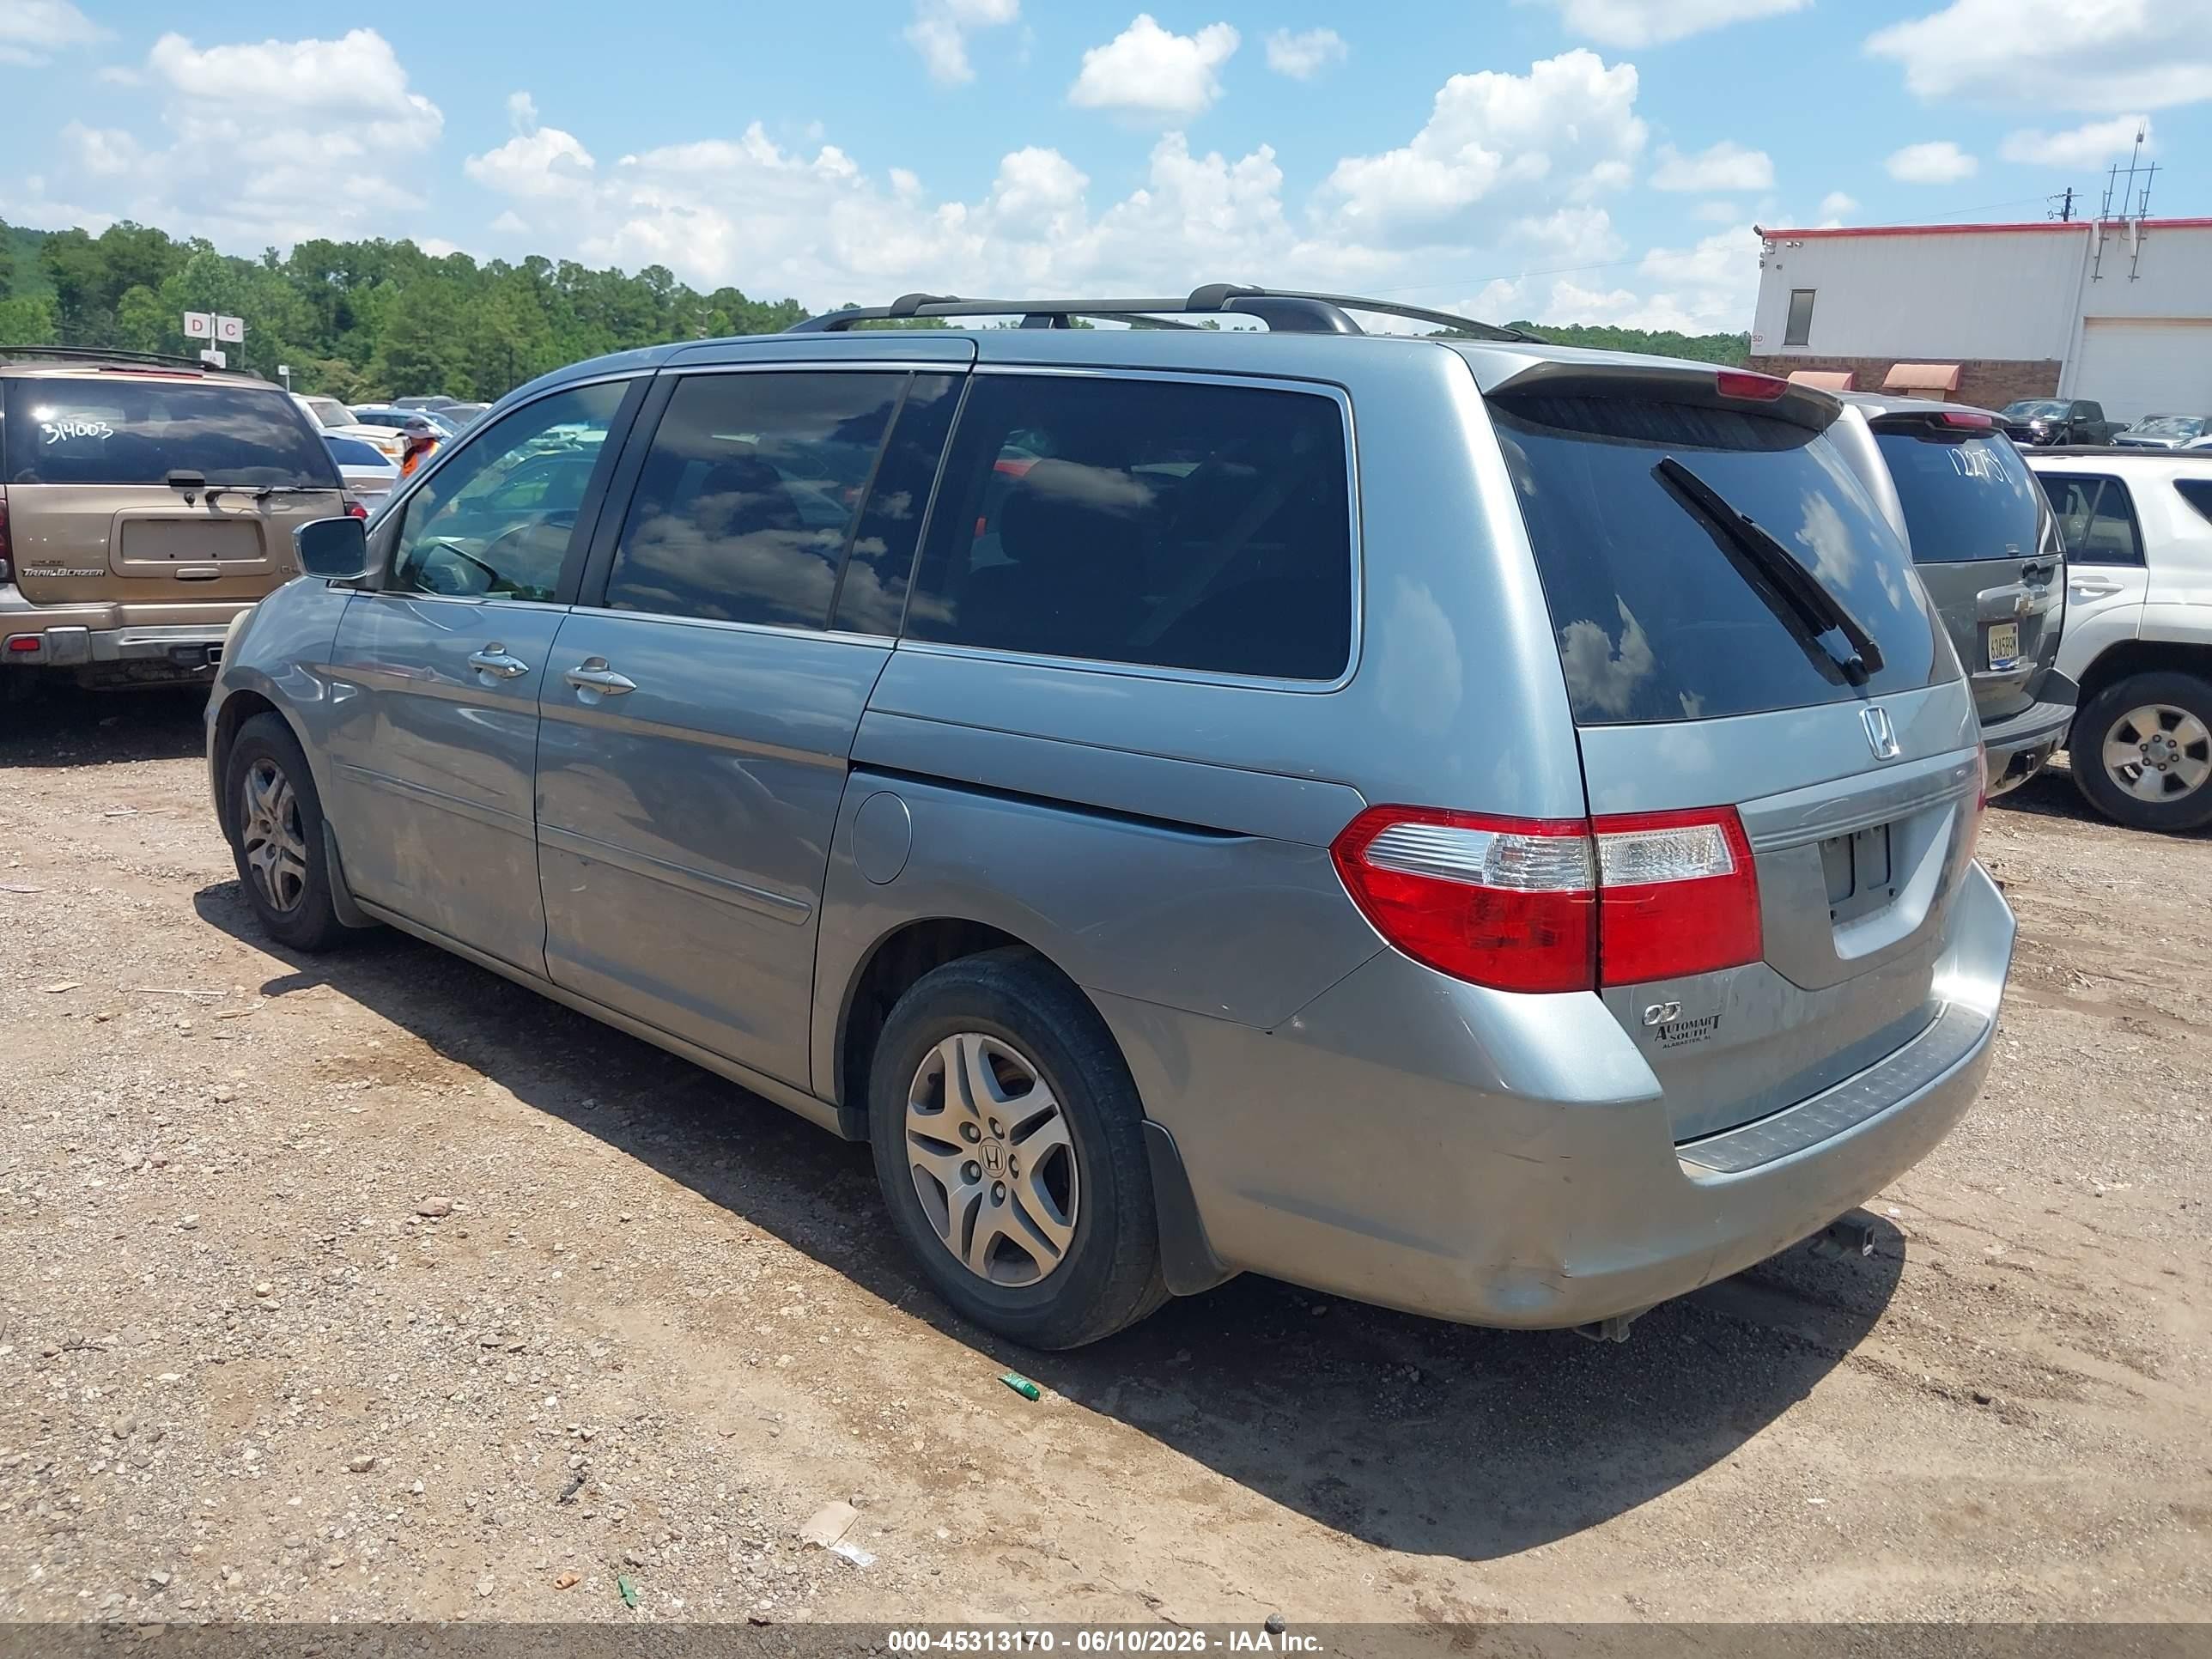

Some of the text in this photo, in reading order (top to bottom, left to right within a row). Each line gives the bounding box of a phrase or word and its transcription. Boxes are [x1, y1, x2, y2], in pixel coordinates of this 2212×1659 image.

[192, 319, 203, 331] D
[226, 324, 236, 336] C
[40, 421, 114, 445] 314003
[1655, 1014, 1722, 1042] AUTOMART
[1669, 1028, 1708, 1042] SOUTH
